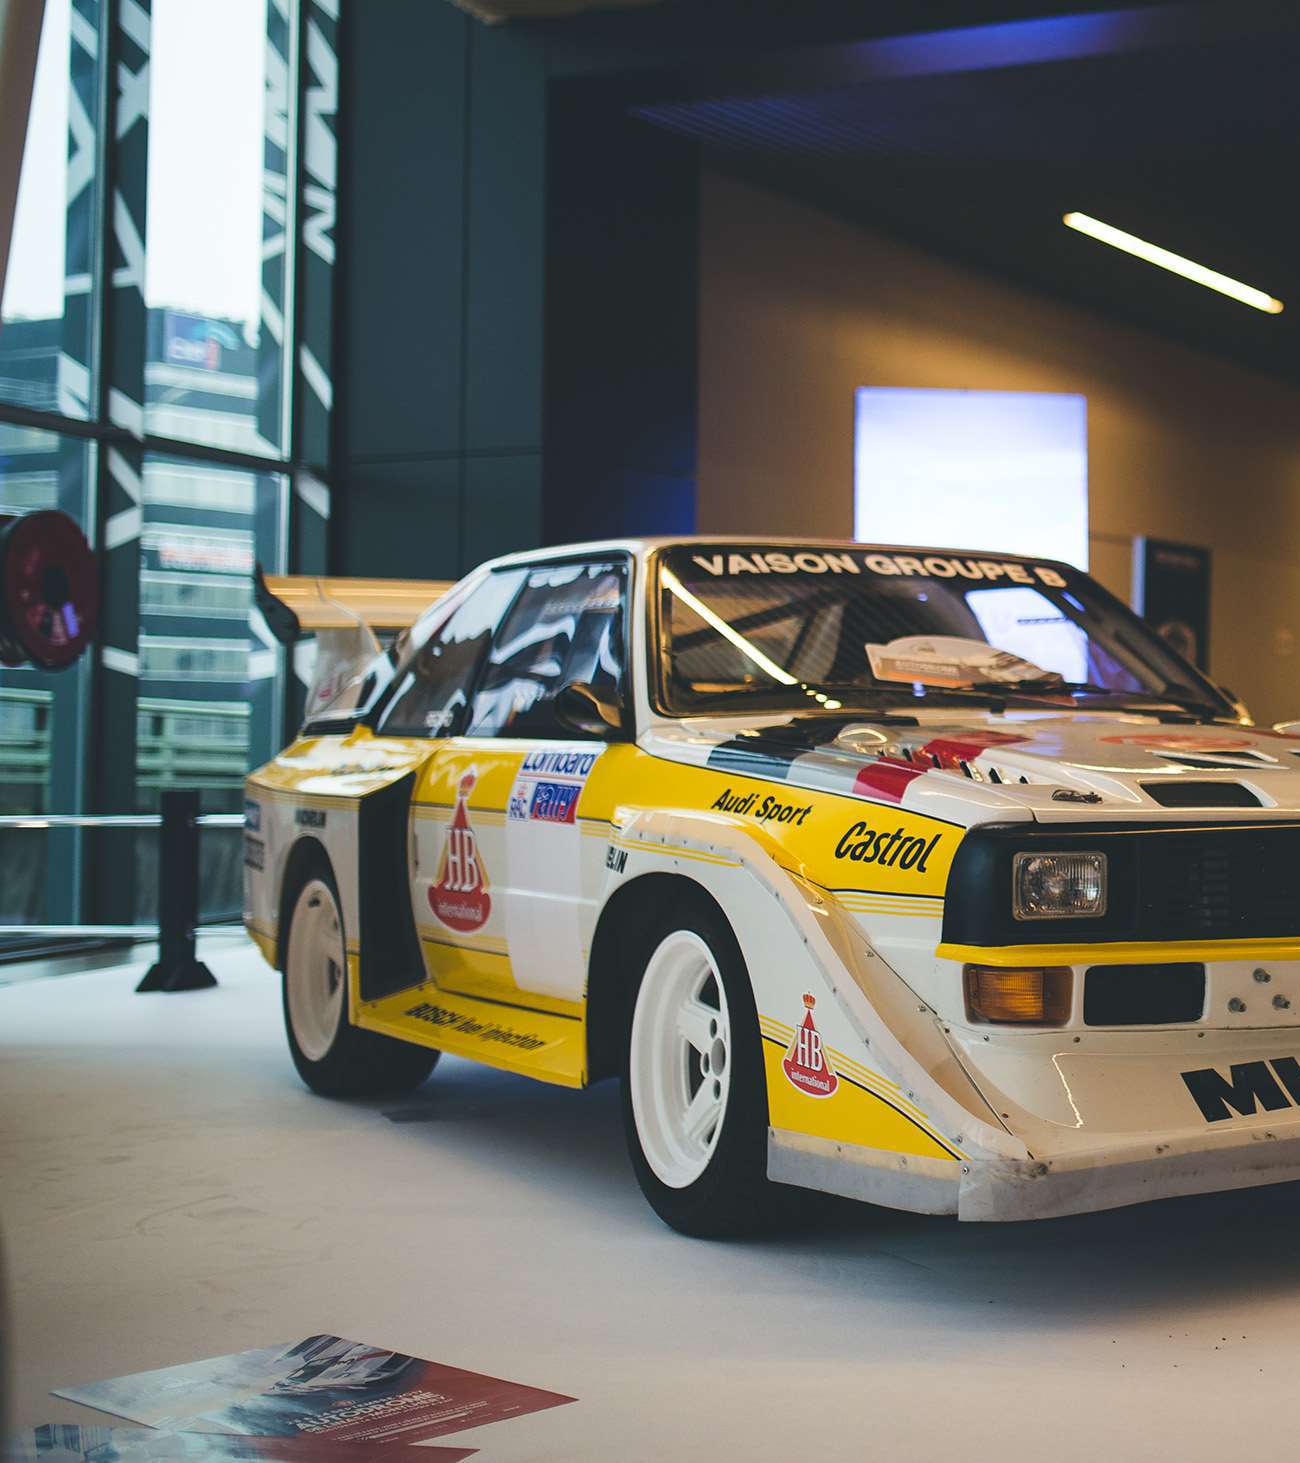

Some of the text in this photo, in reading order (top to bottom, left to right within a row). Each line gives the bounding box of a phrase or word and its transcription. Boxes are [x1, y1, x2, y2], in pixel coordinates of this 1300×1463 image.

[692, 553, 1067, 588] VAISON GROUPE B
[711, 788, 814, 825] Audi Sport
[444, 828, 479, 892] HB
[834, 821, 943, 874] Castrol
[796, 1025, 823, 1072] HB
